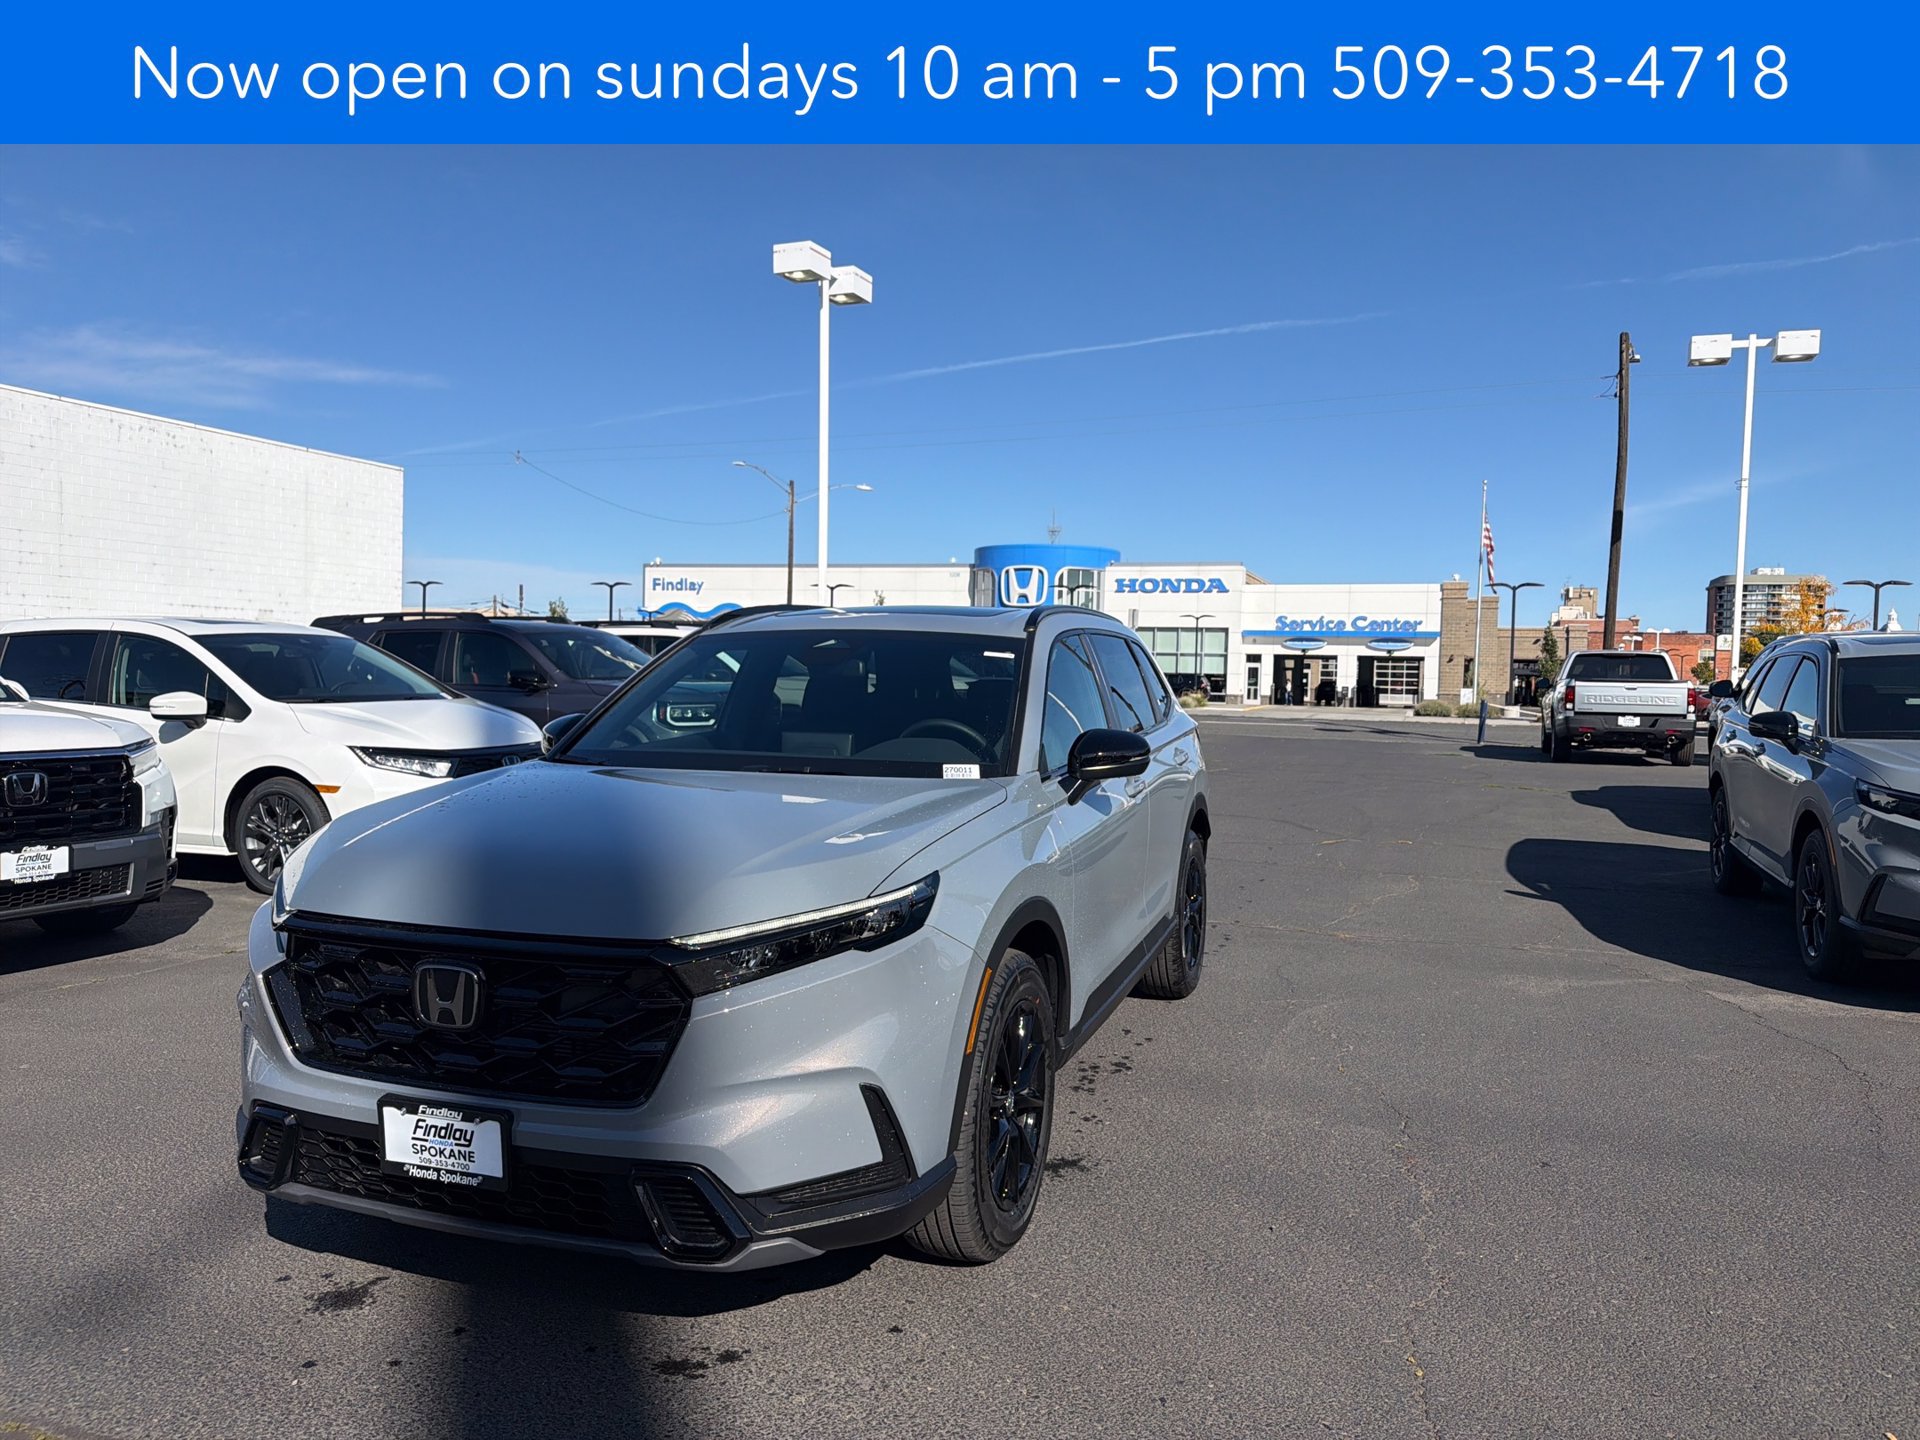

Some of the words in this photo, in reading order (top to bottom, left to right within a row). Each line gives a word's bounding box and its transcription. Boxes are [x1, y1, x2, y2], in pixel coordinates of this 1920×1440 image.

[652, 577, 704, 595] Findlay
[1114, 578, 1230, 593] HONDA
[1275, 615, 1346, 631] Service
[1350, 615, 1423, 632] Center
[1584, 694, 1677, 705] RIDGELINE
[16, 853, 52, 866] Findlay
[15, 864, 52, 873] SPOKANE
[417, 1105, 463, 1121] Findlay
[412, 1119, 474, 1147] Findlay
[428, 1138, 455, 1147] HONDA
[411, 1144, 476, 1163] SPOKANE
[418, 1156, 470, 1171] 509-353-4700
[409, 1165, 438, 1180] Honda
[439, 1170, 478, 1186] Spokane
